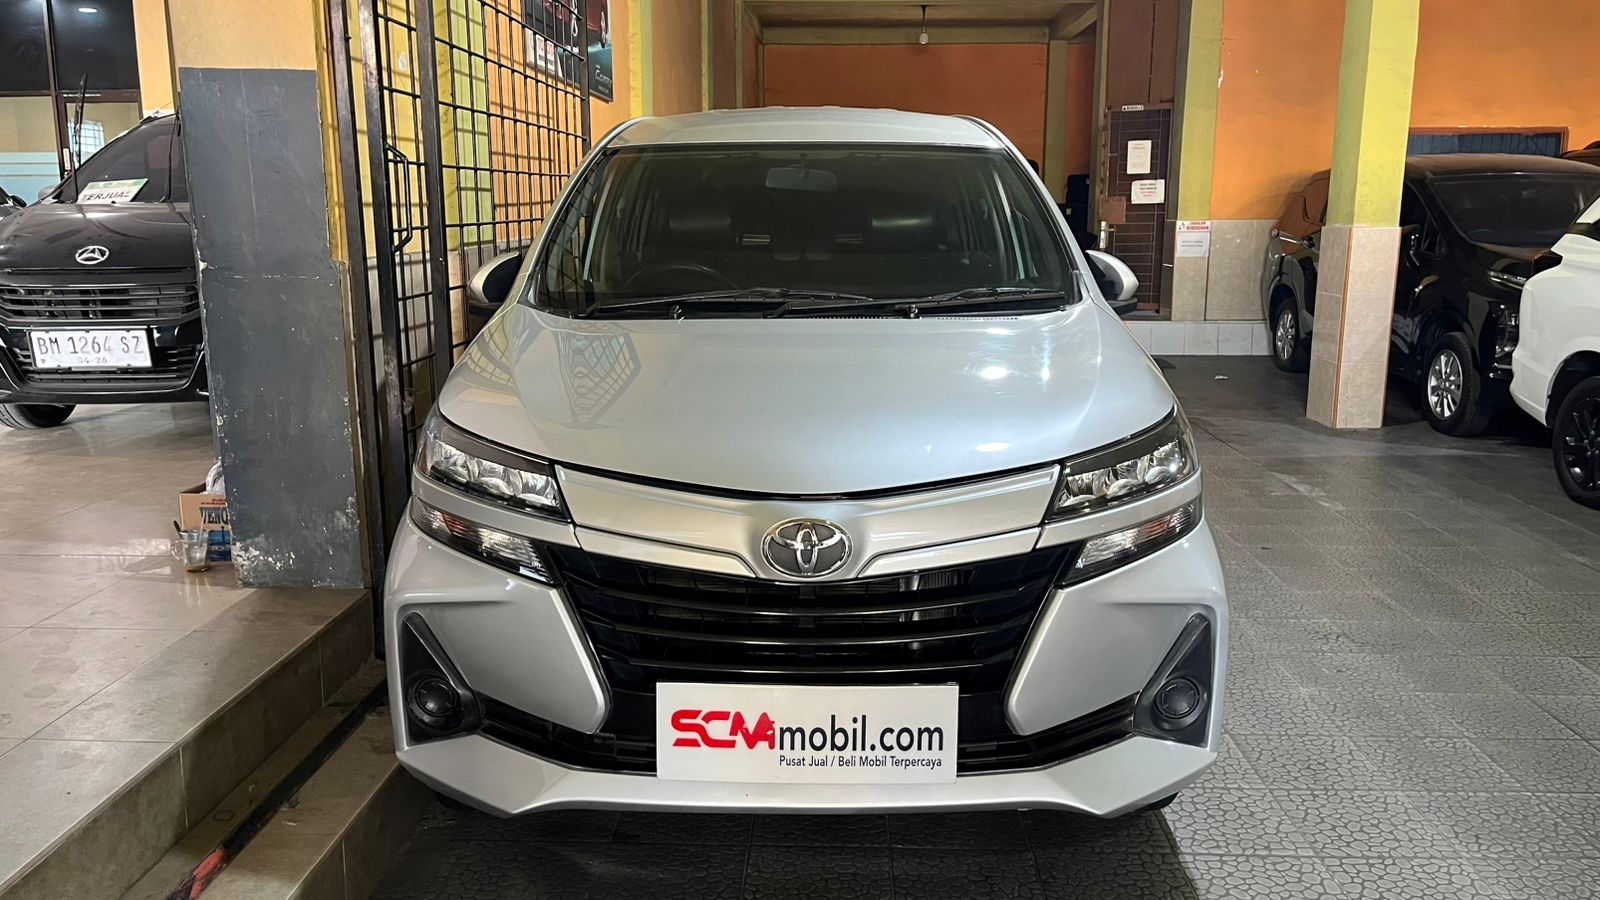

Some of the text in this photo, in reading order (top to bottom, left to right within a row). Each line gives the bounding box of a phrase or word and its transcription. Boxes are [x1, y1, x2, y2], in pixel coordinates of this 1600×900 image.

[37, 336, 61, 355] BM
[120, 335, 145, 355] SZ
[779, 754, 942, 770] Pusat Jual / Beli Mobil Terpercaya
